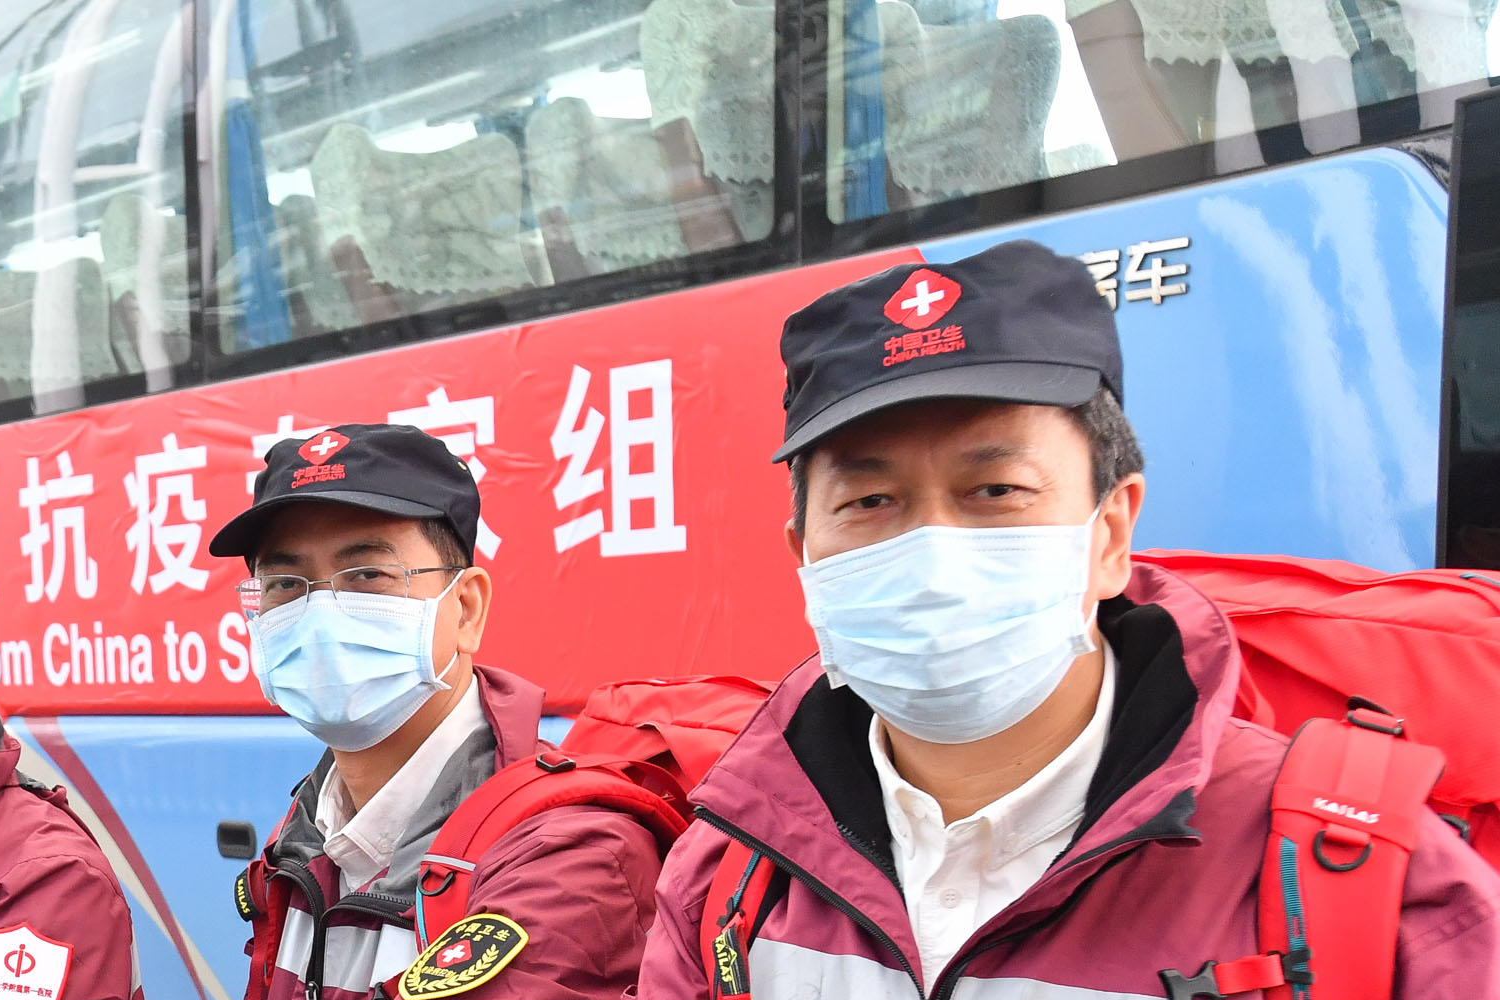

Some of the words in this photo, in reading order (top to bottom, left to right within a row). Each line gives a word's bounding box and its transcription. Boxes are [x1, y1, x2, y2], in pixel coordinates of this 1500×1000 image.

[884, 325, 964, 356] 中国卫生
[920, 339, 967, 357] HEALTH
[43, 621, 154, 686] China
[164, 621, 208, 682] to
[1312, 797, 1381, 824] KAILAS
